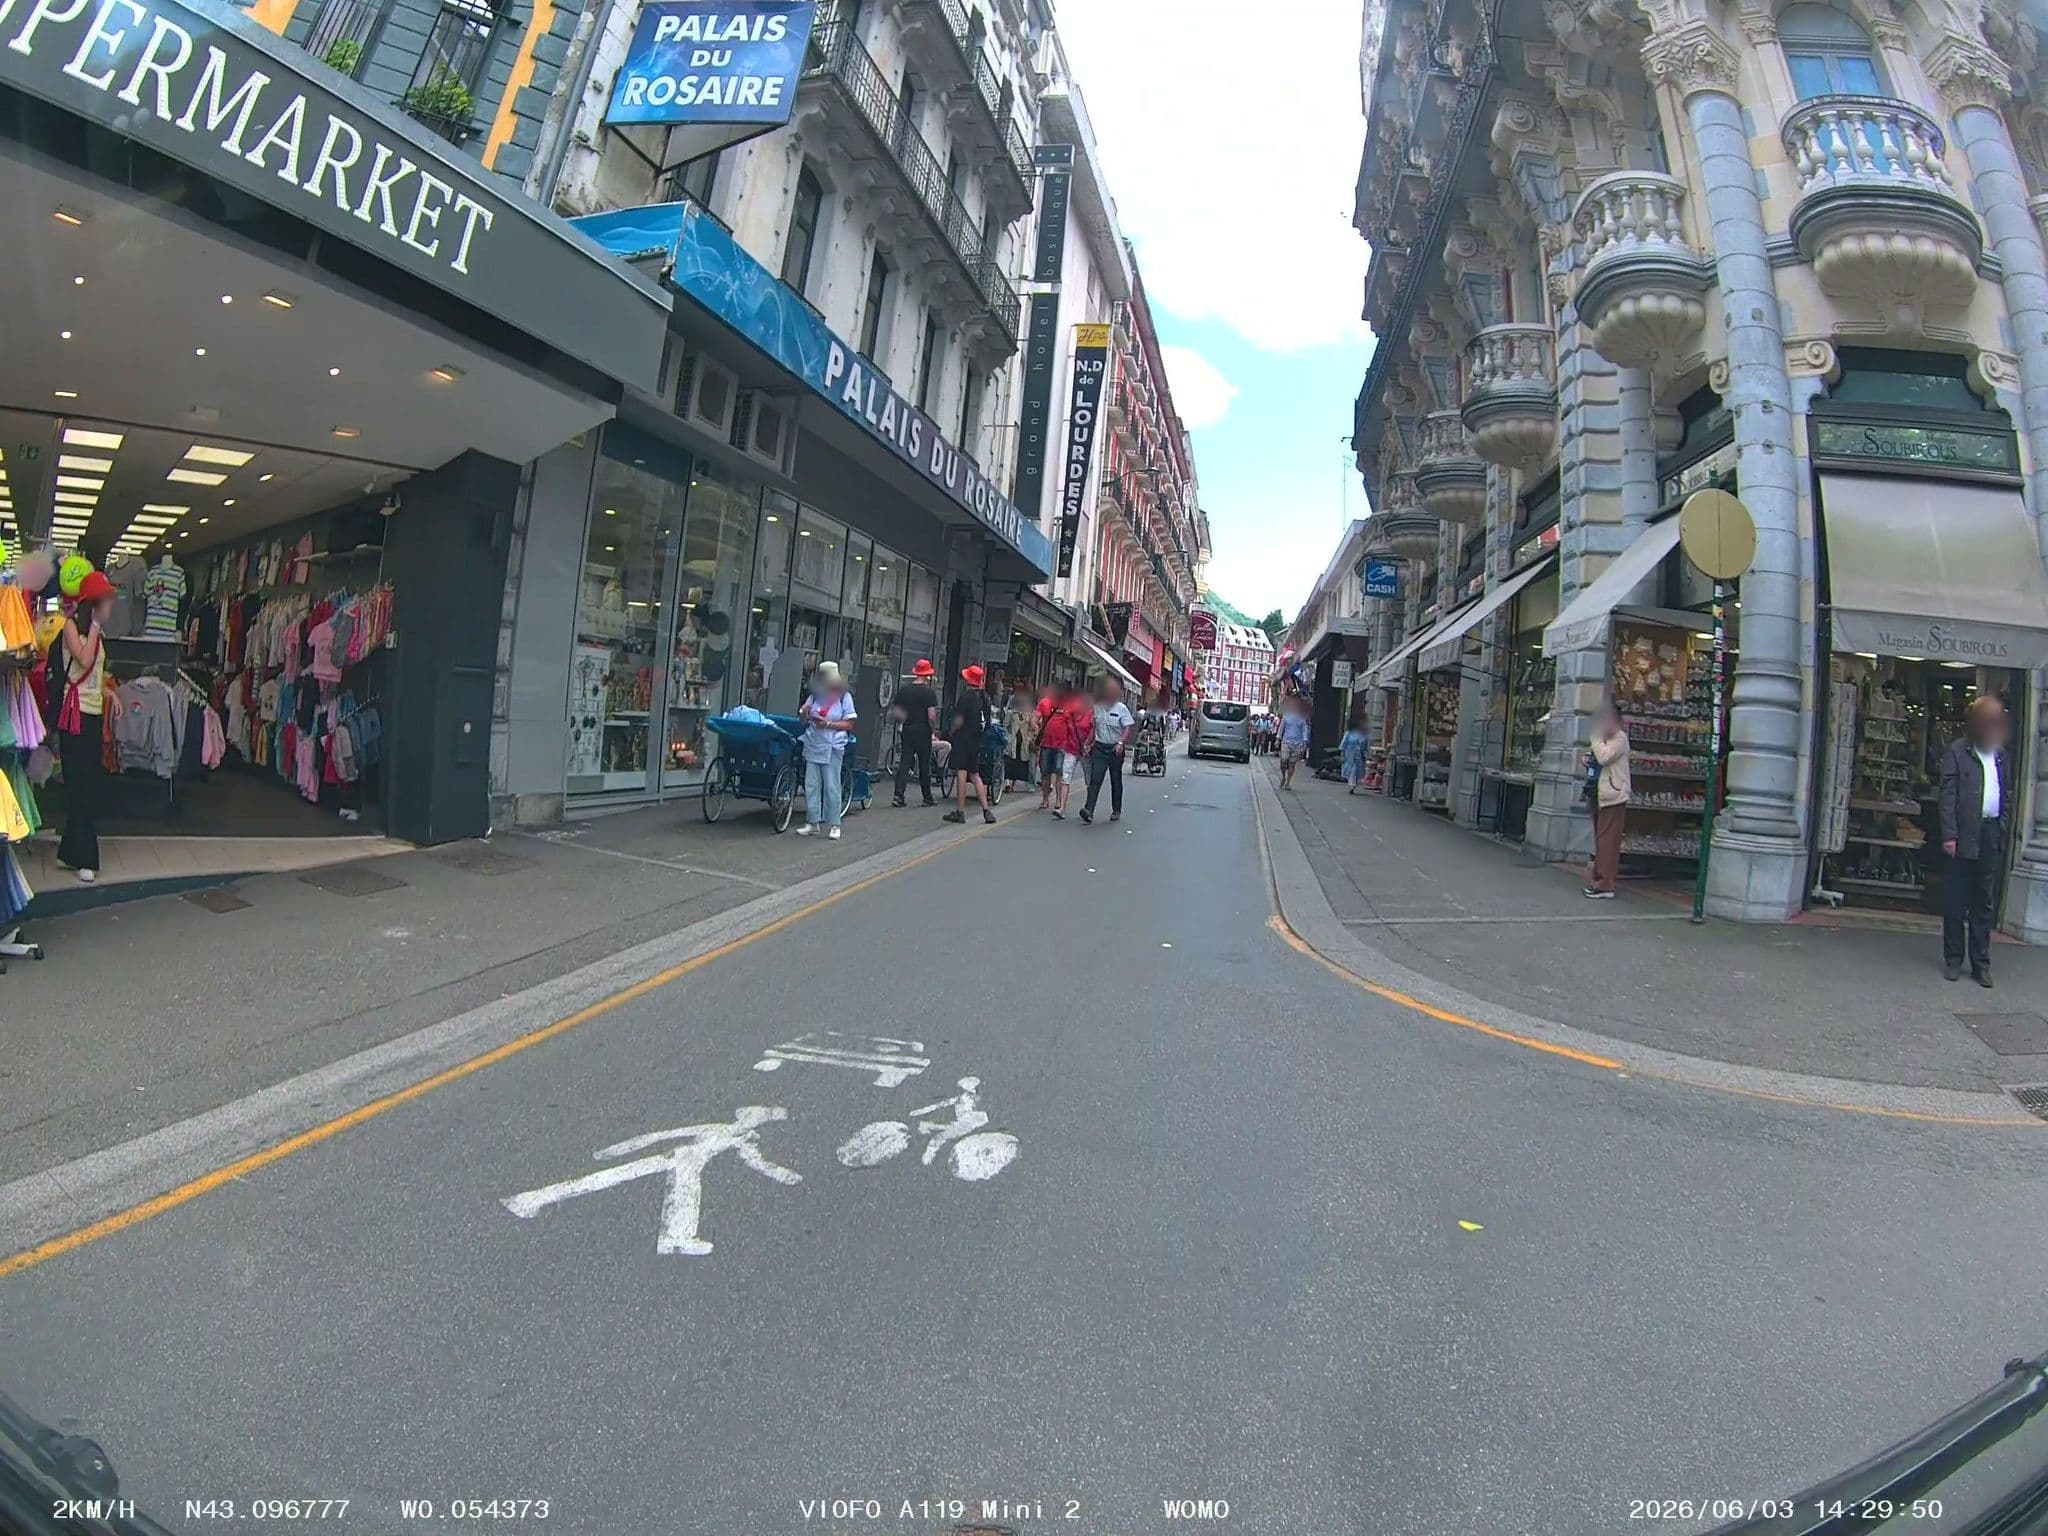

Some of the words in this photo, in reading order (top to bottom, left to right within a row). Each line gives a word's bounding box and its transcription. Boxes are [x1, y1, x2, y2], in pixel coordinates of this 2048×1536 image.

[653, 14, 788, 42] PALAIS
[690, 49, 732, 67] DU
[622, 75, 785, 106] ROSAIRE
[0, 0, 495, 275] PERMARKET
[1043, 177, 1063, 276] basilique
[1033, 305, 1049, 370] hotel
[1079, 374, 1095, 385] de
[824, 340, 922, 458] PALAIS
[930, 436, 959, 488] DU
[964, 468, 1024, 546] ROSAIRE
[1026, 400, 1041, 476] grand
[1065, 390, 1093, 517] LOURDES
[1366, 583, 1396, 594] CASH
[1878, 631, 1923, 651] Magasin
